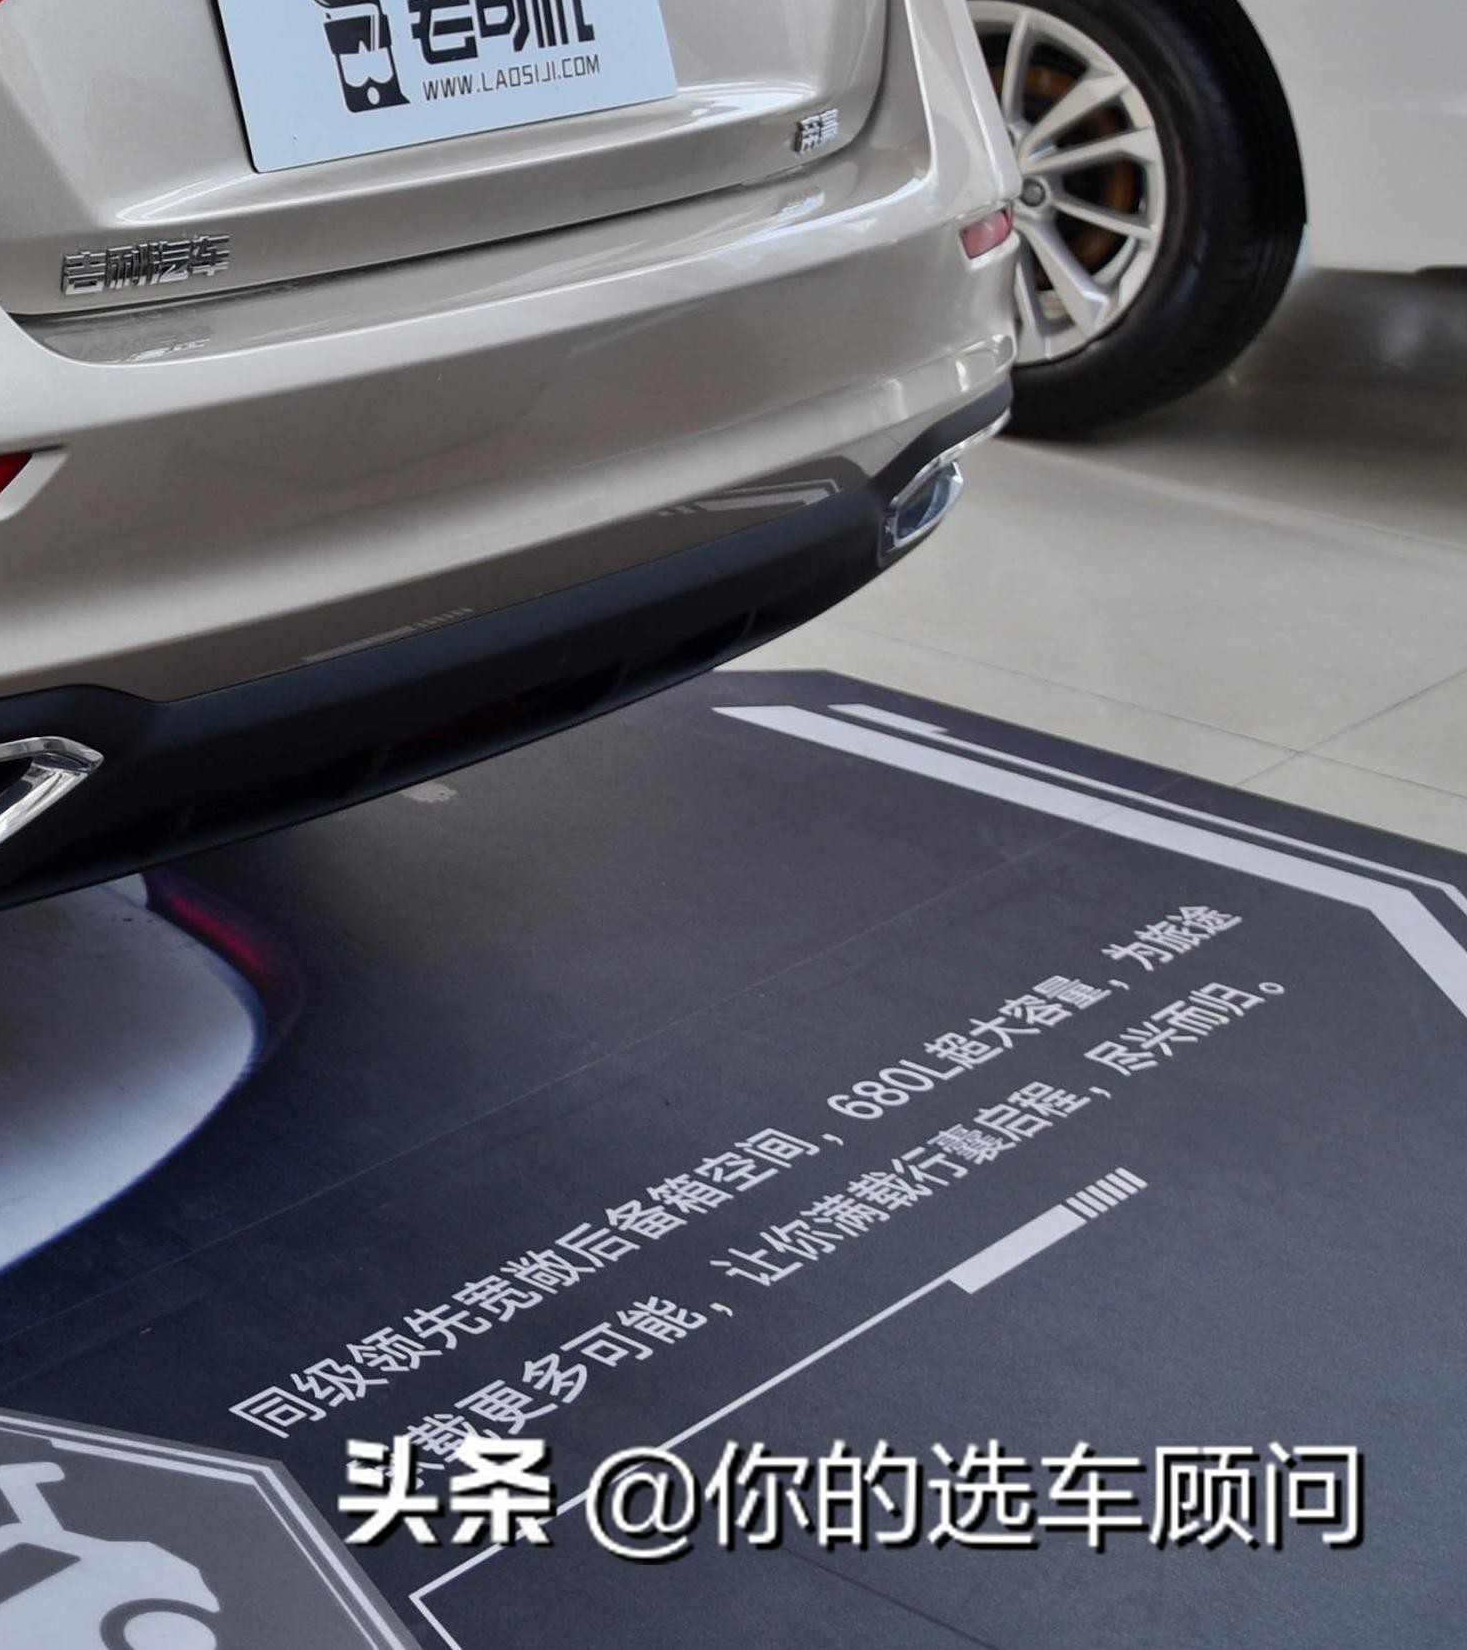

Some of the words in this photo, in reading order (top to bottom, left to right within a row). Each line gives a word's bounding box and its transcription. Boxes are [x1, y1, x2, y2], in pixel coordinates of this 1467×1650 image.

[422, 53, 601, 101] WWW.LAOSIJI.COM
[63, 234, 231, 296] 吉利汽车
[345, 979, 1286, 1492] 载更多可能，让你满载行囊启程，尽兴而归。
